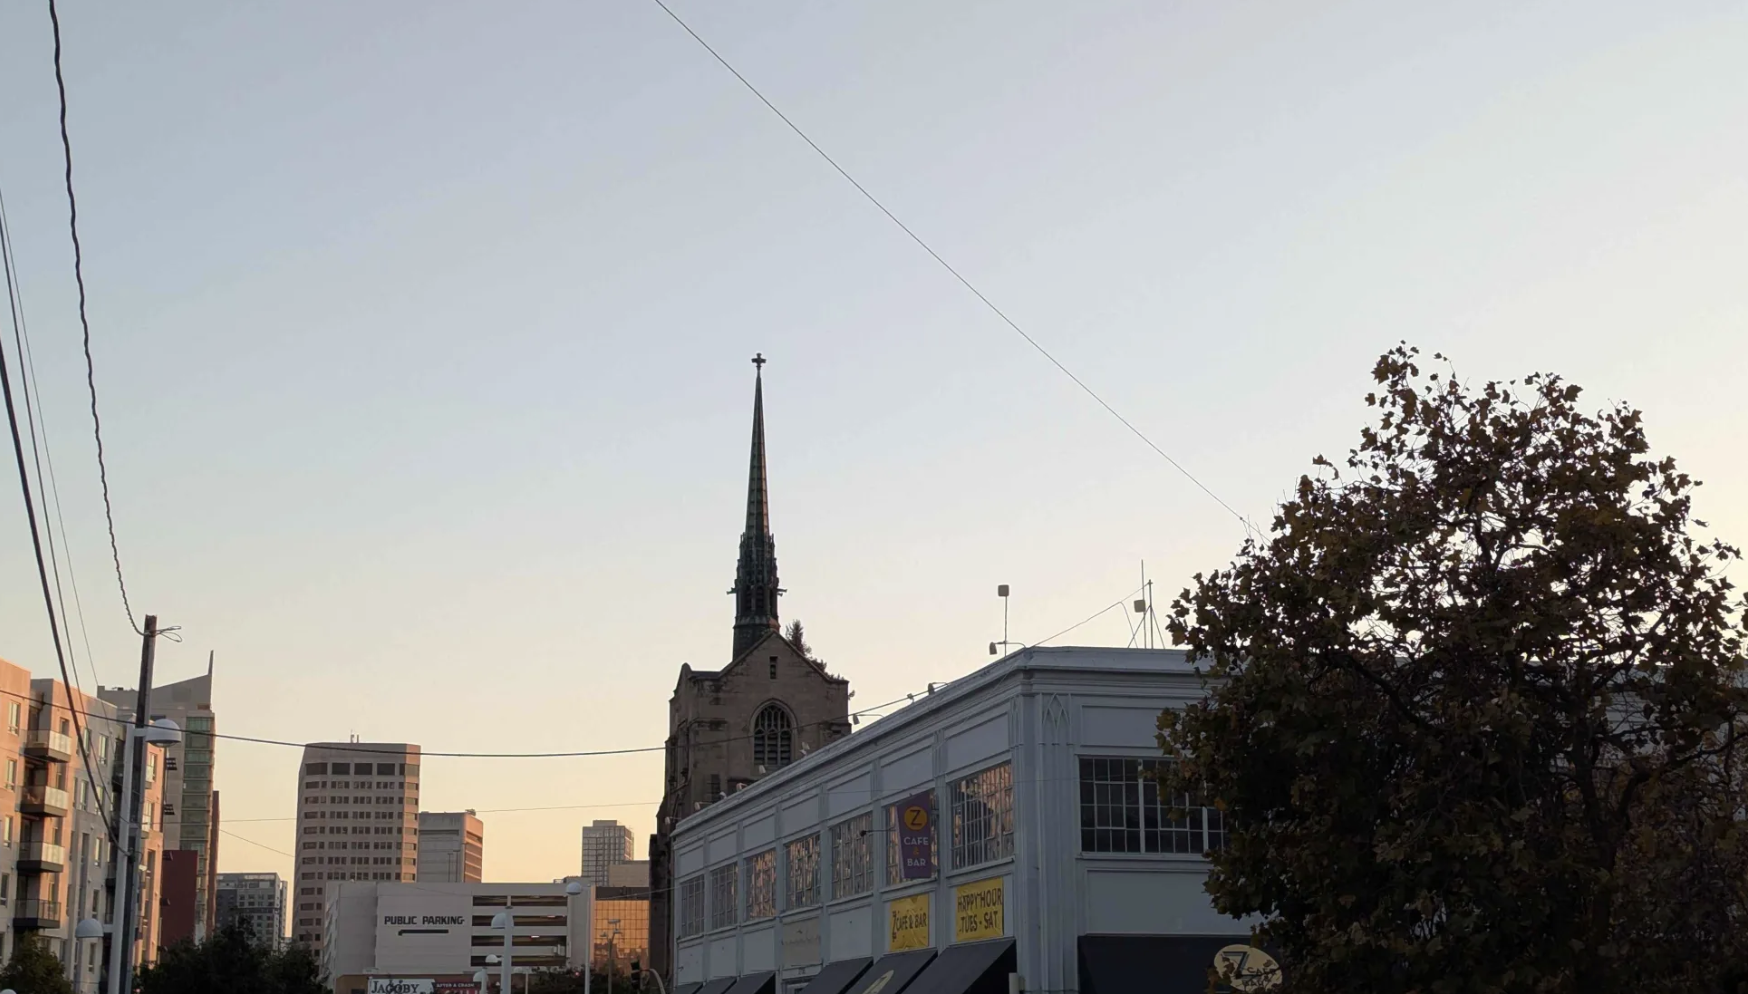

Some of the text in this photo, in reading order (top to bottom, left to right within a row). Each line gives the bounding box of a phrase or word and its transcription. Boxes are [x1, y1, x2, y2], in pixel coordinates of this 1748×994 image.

[909, 809, 923, 826] Z
[903, 837, 929, 846] CAFE
[907, 859, 926, 867] BAR
[957, 887, 1003, 912] HAPPY HOUR
[384, 916, 465, 925] PUBLIC PARKING
[914, 912, 927, 929] BAR
[961, 915, 978, 934] TUES
[983, 910, 999, 930] SAT
[371, 980, 420, 994] JACOBY
